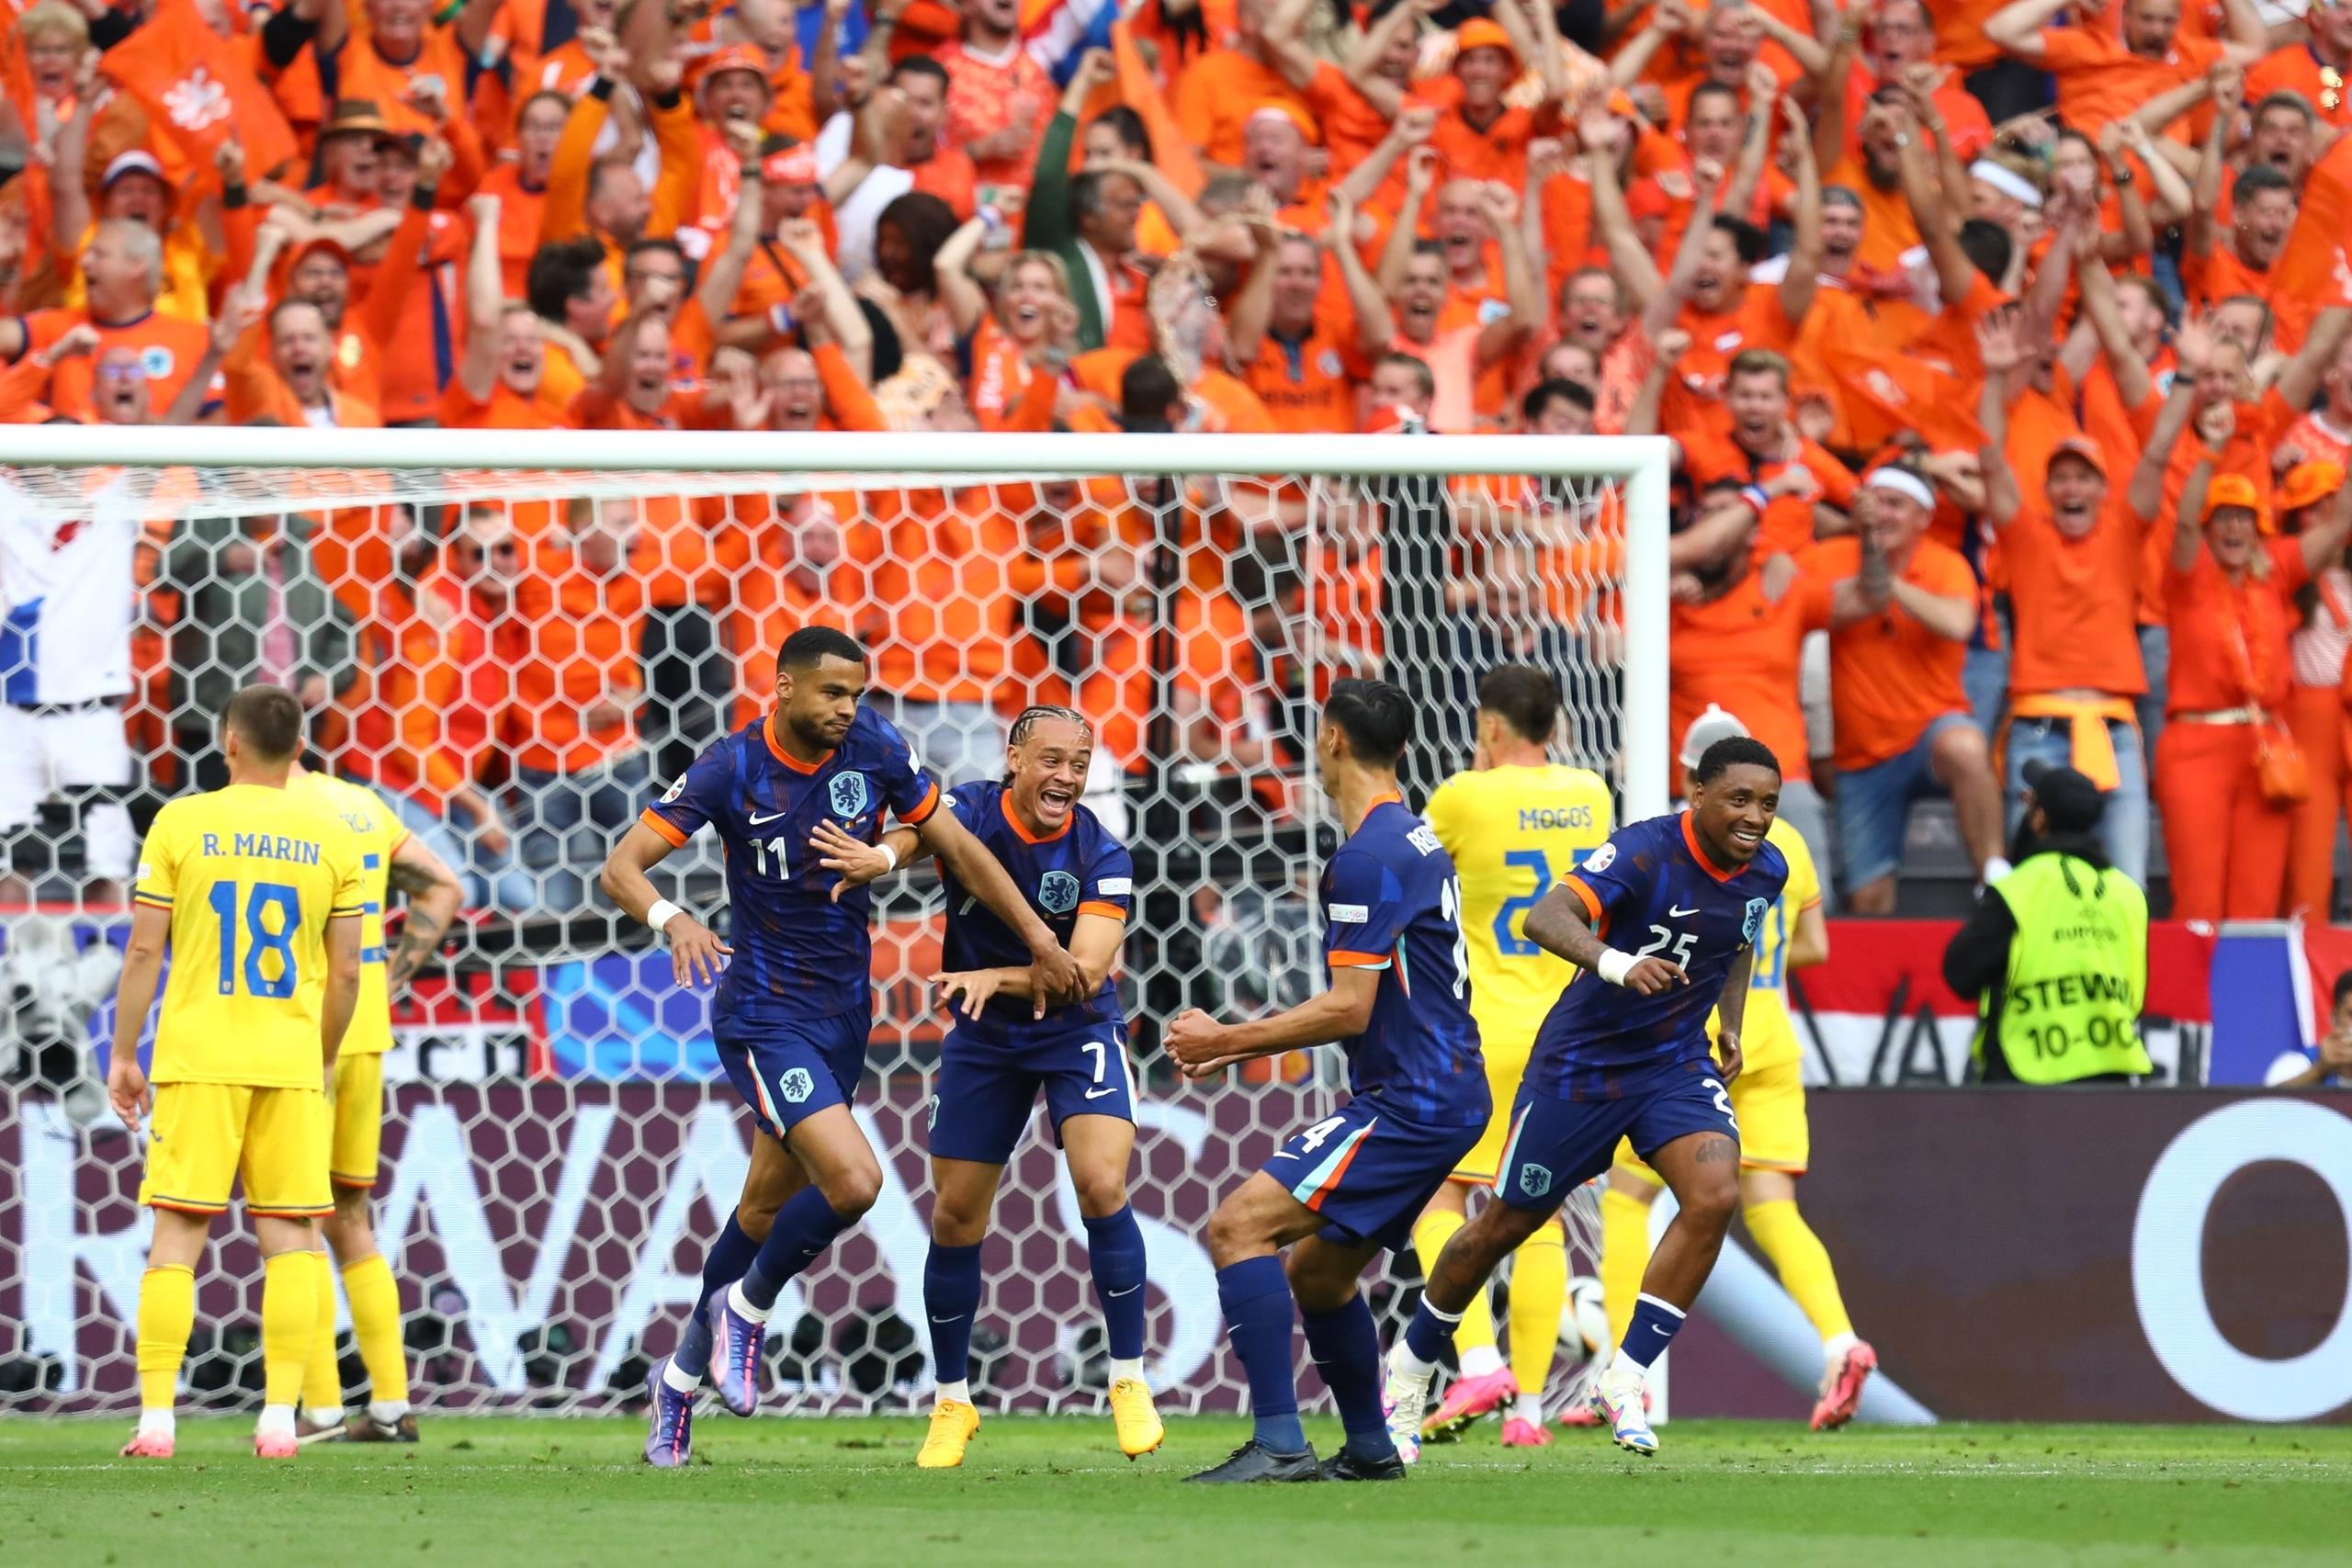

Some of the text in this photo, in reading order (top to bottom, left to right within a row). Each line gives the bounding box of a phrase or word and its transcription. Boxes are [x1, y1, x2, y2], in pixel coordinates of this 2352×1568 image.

[203, 833, 320, 865] R. MARIN
[748, 837, 789, 880] 11
[208, 881, 301, 999] 18
[1635, 924, 1699, 979] 25
[1081, 1042, 1105, 1083] 7
[1288, 1116, 1346, 1154] 4
